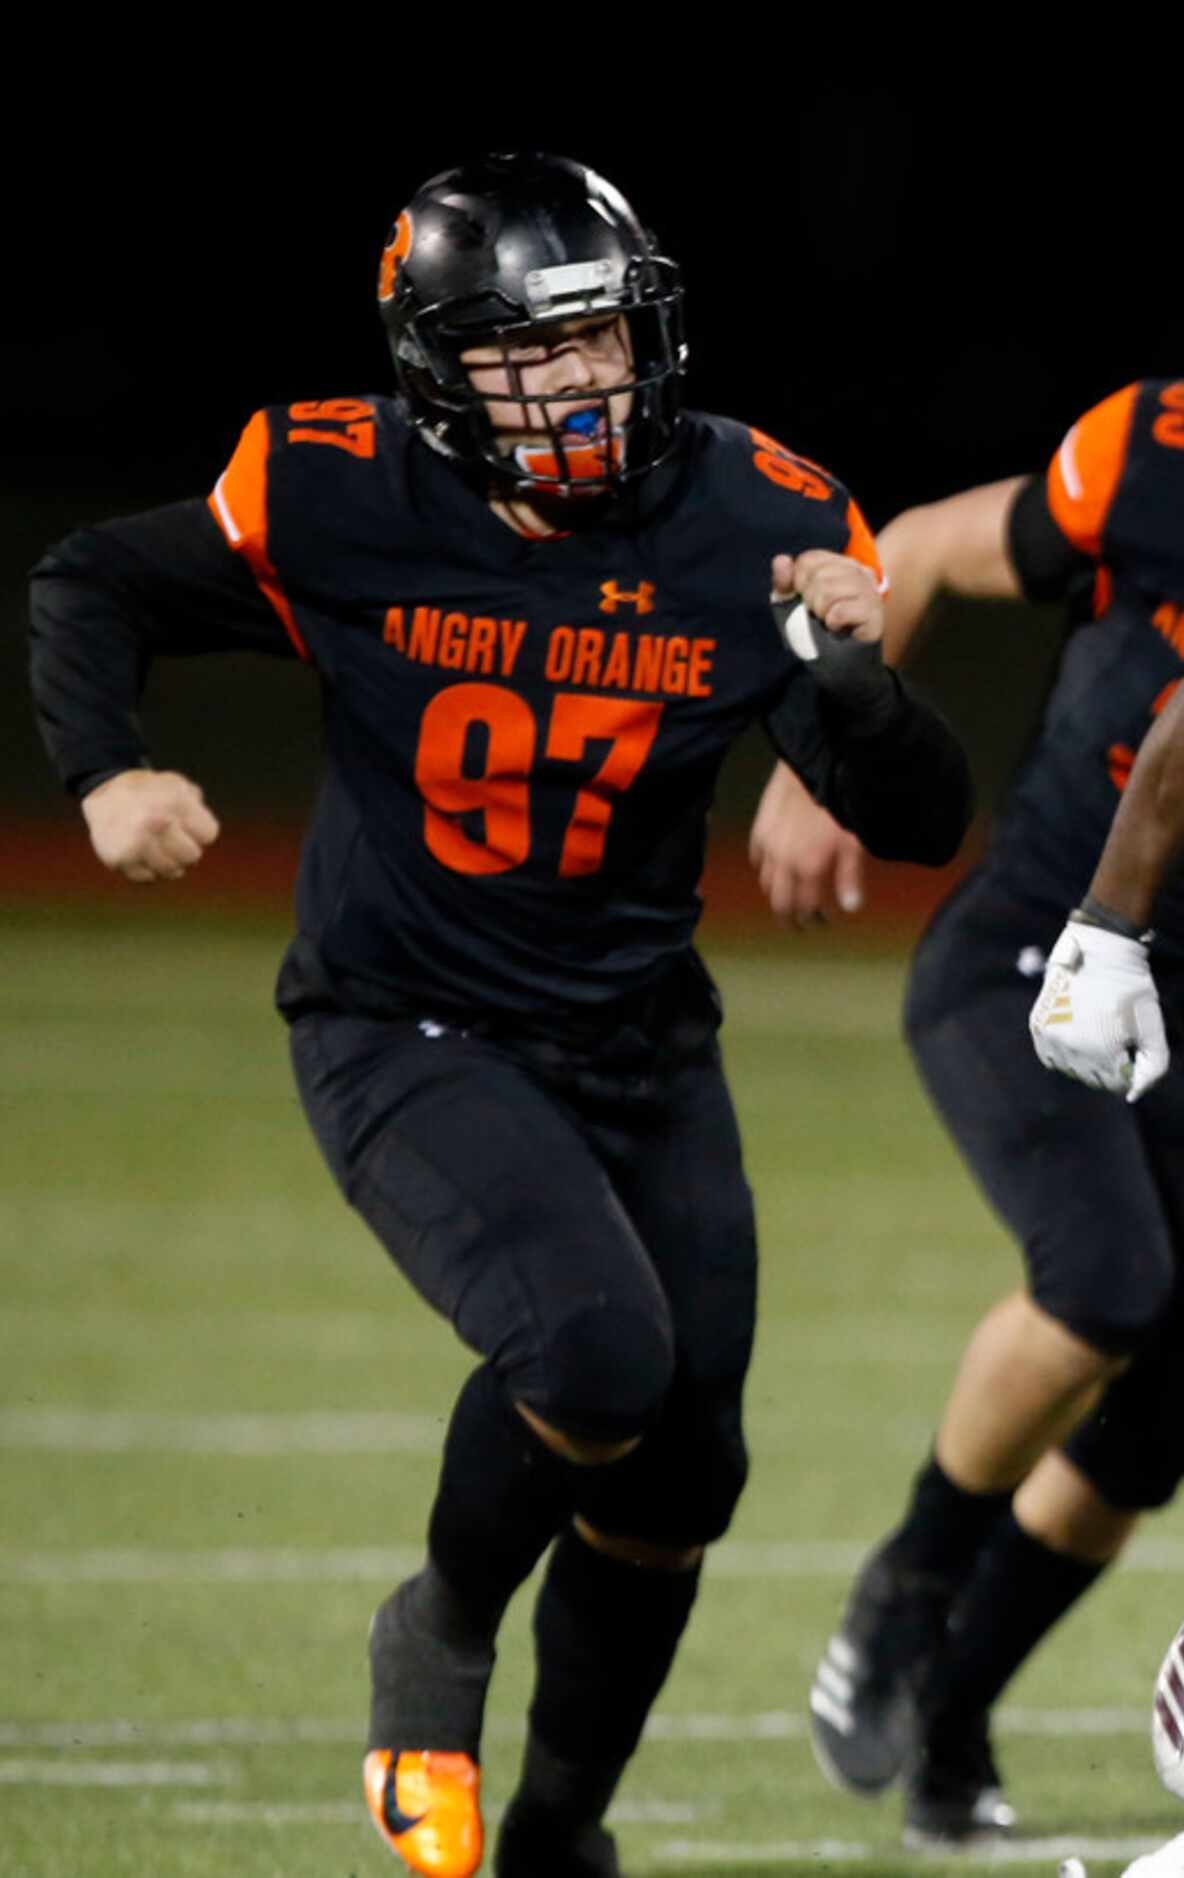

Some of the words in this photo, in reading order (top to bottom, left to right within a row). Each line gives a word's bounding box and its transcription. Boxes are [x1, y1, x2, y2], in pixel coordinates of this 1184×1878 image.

[287, 397, 376, 460] 97
[383, 606, 528, 676] ANGRY
[545, 624, 717, 698] ORANGE
[414, 681, 665, 877] 97
